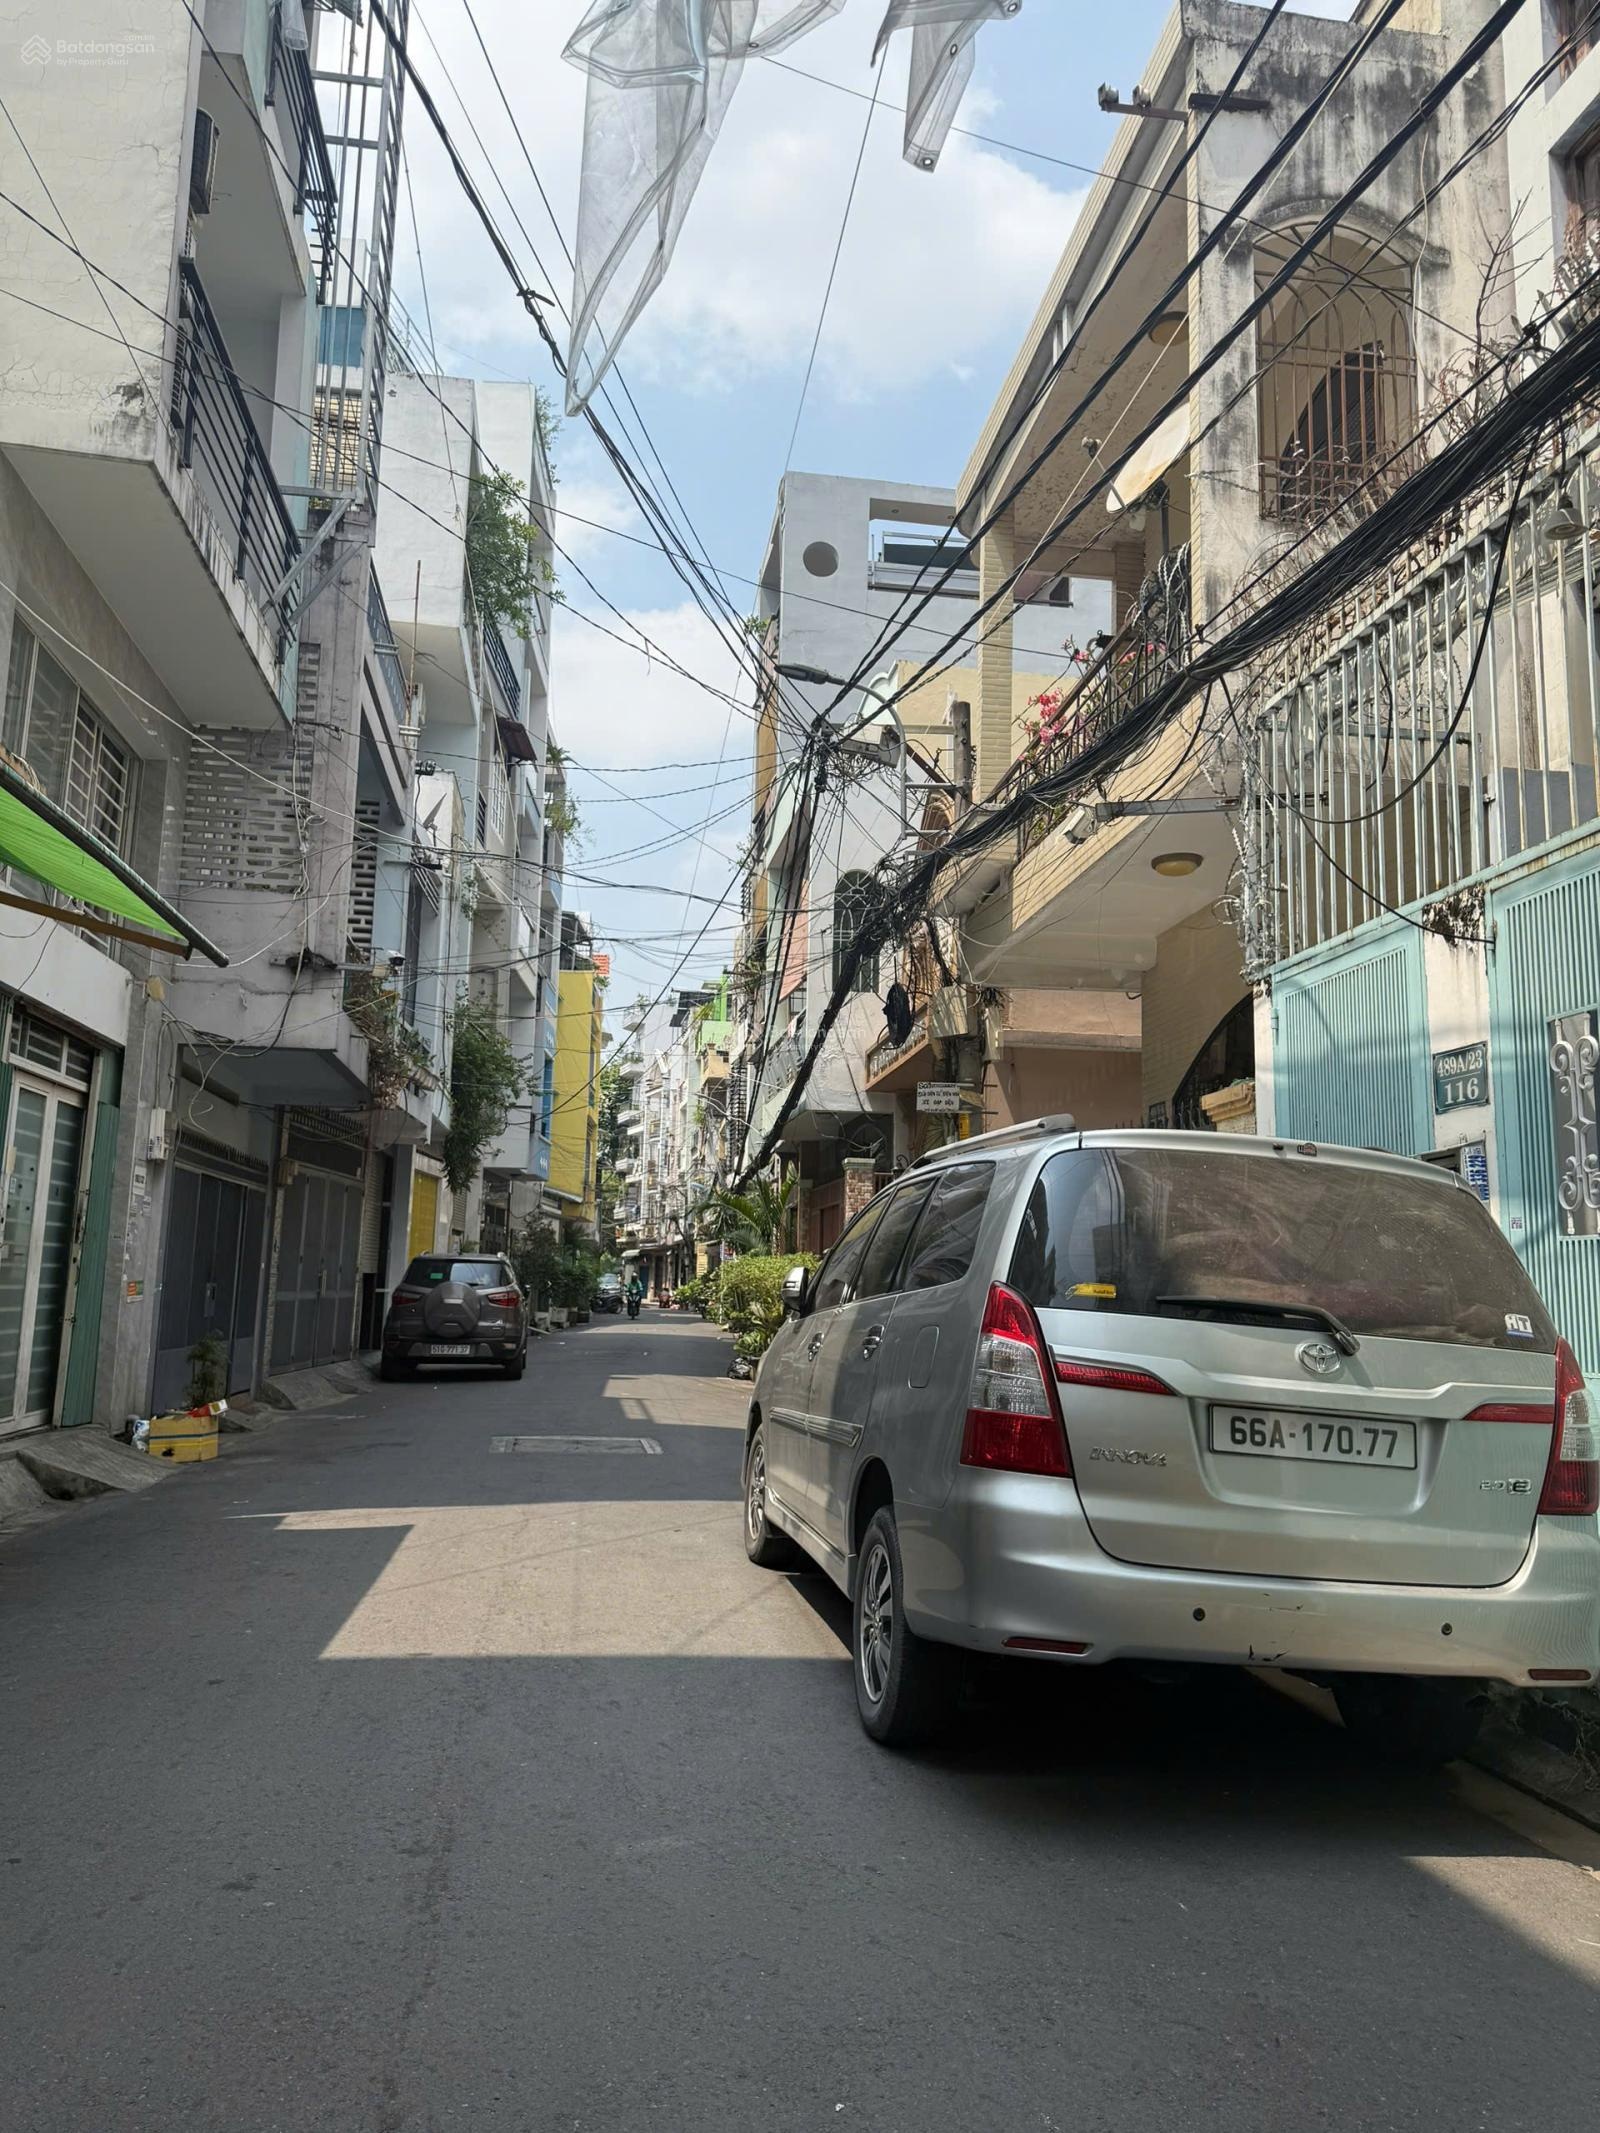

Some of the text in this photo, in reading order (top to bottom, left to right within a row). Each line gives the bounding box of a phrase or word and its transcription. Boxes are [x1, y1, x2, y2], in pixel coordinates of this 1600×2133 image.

[1437, 1049, 1483, 1078] 489A/23
[1444, 1077, 1479, 1105] 116
[1230, 1415, 1398, 1458] 66A-170.77
[1088, 1446, 1169, 1467] INNOVA
